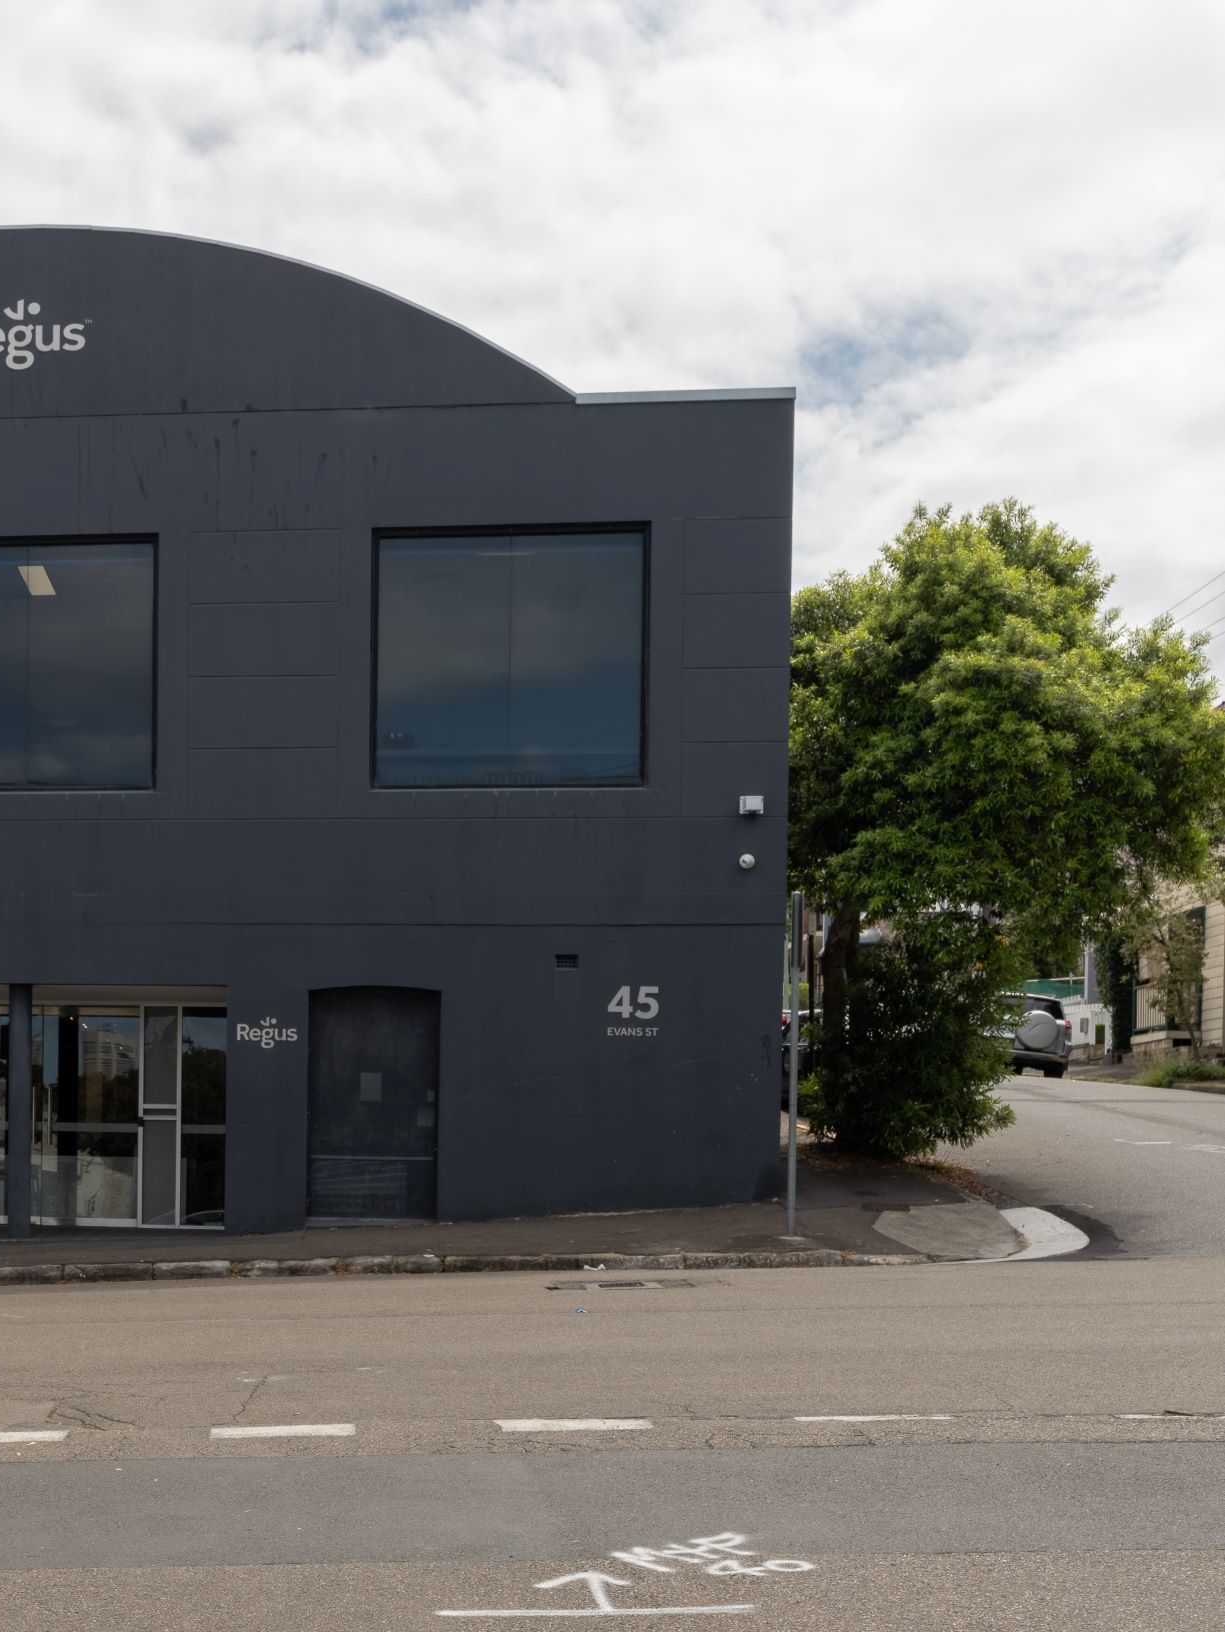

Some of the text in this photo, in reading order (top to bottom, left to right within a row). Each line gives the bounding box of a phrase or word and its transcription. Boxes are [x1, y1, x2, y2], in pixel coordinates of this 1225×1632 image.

[607, 985, 660, 1020] 45
[236, 1022, 298, 1049] Regus
[607, 1027, 659, 1037] EVANS ST
